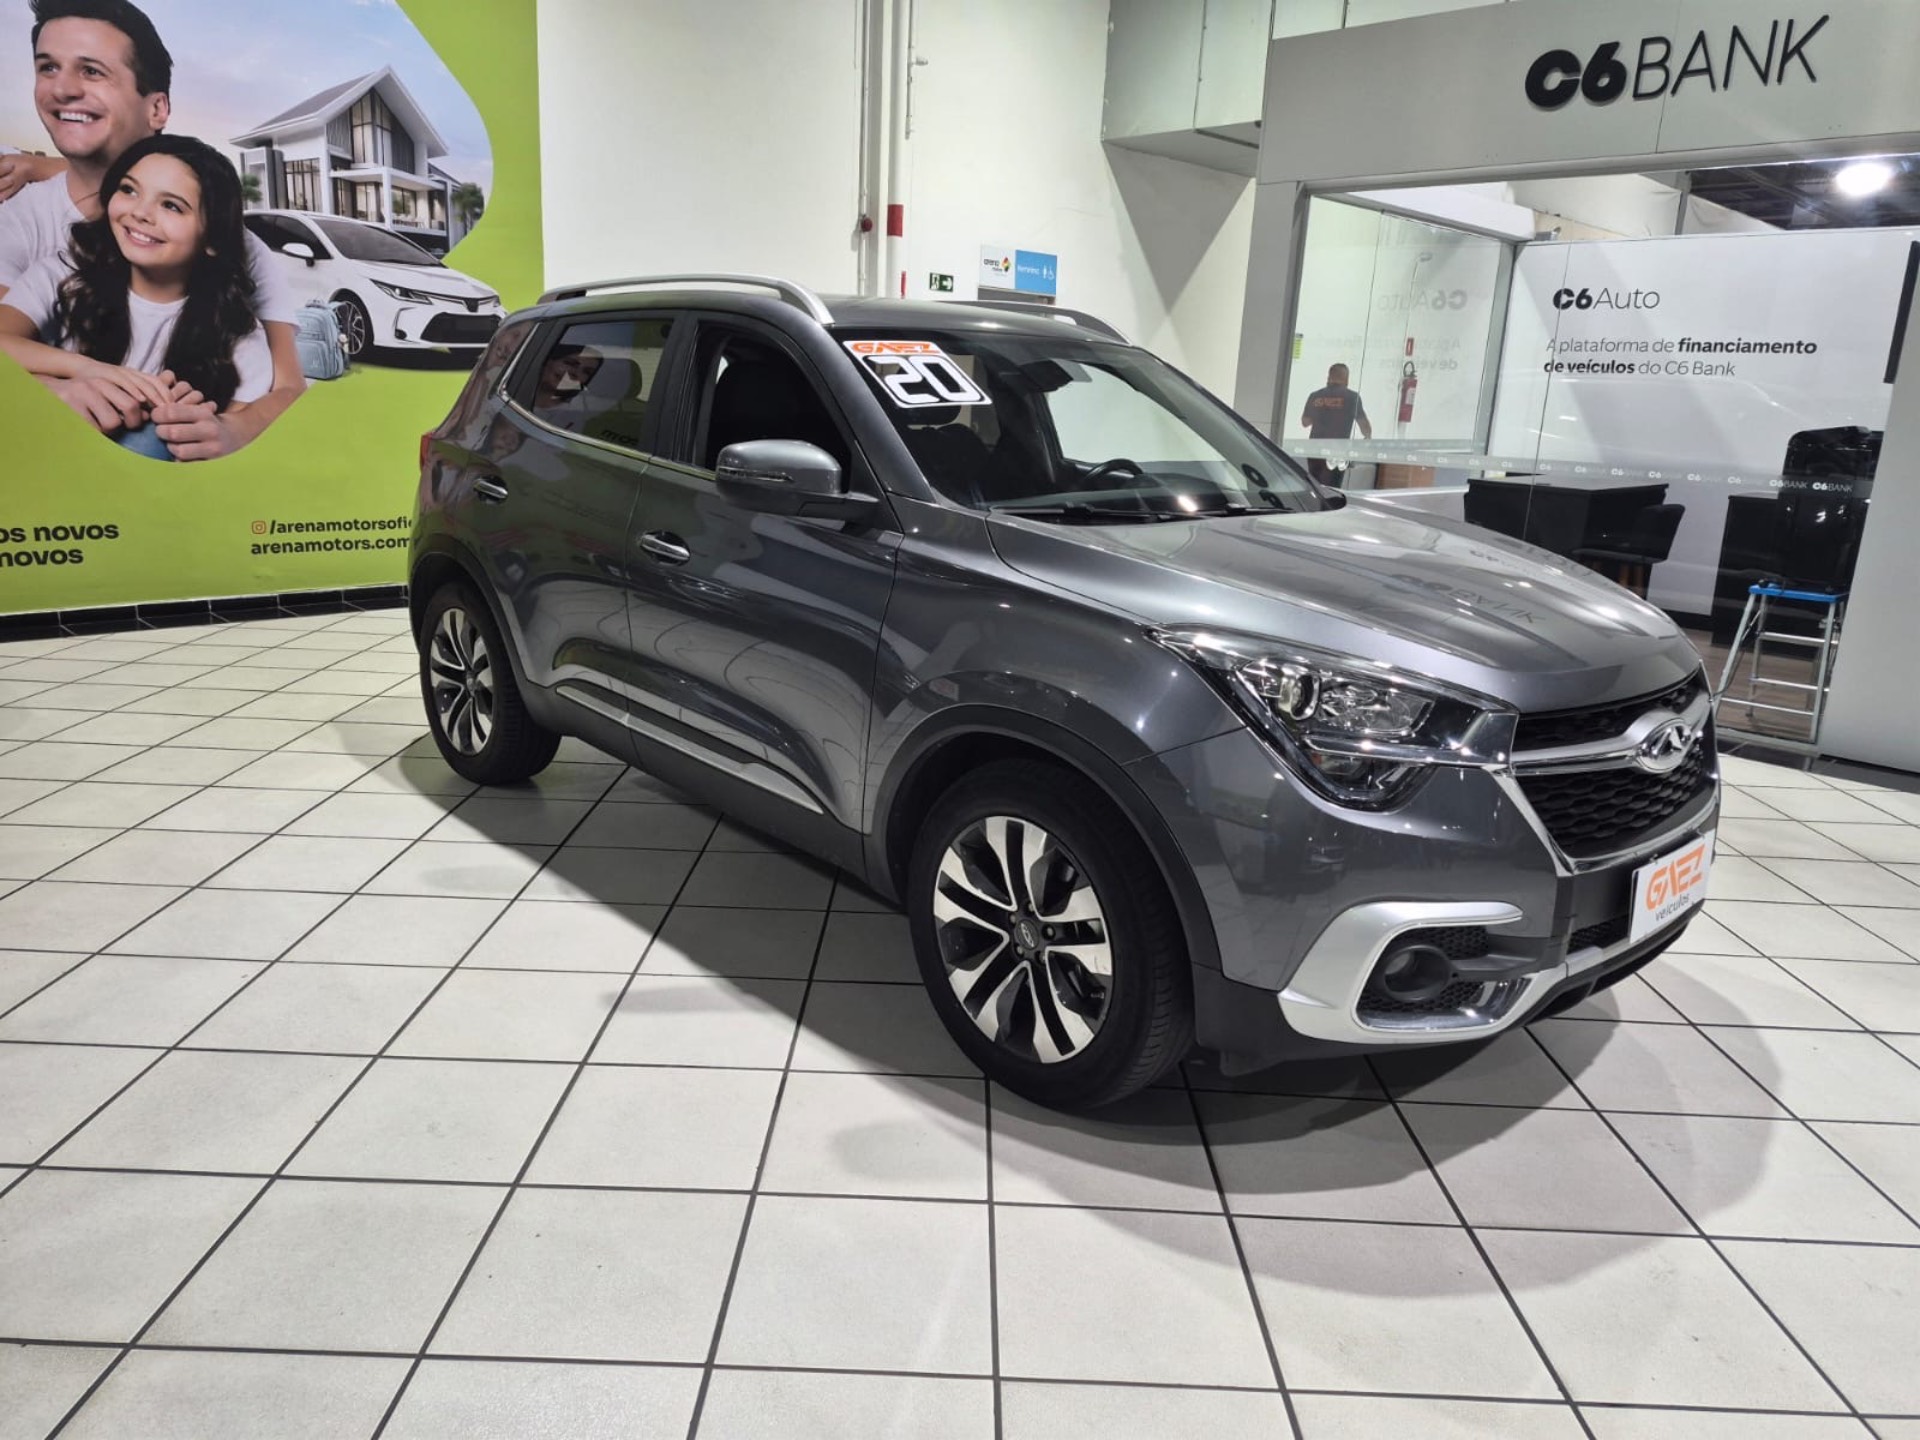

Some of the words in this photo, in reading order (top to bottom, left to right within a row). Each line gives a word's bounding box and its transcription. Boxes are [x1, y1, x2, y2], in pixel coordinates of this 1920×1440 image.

[1552, 287, 1661, 311] C6Auto
[1559, 337, 1649, 354] plataforma
[1652, 338, 1675, 353] de
[1677, 337, 1818, 354] financiamento
[1543, 360, 1564, 373] de
[1567, 359, 1635, 374] veículos
[1638, 361, 1661, 374] do
[1664, 361, 1689, 375] C6
[1692, 361, 1736, 376] Bank
[866, 355, 983, 404] 20
[33, 524, 119, 542] novos
